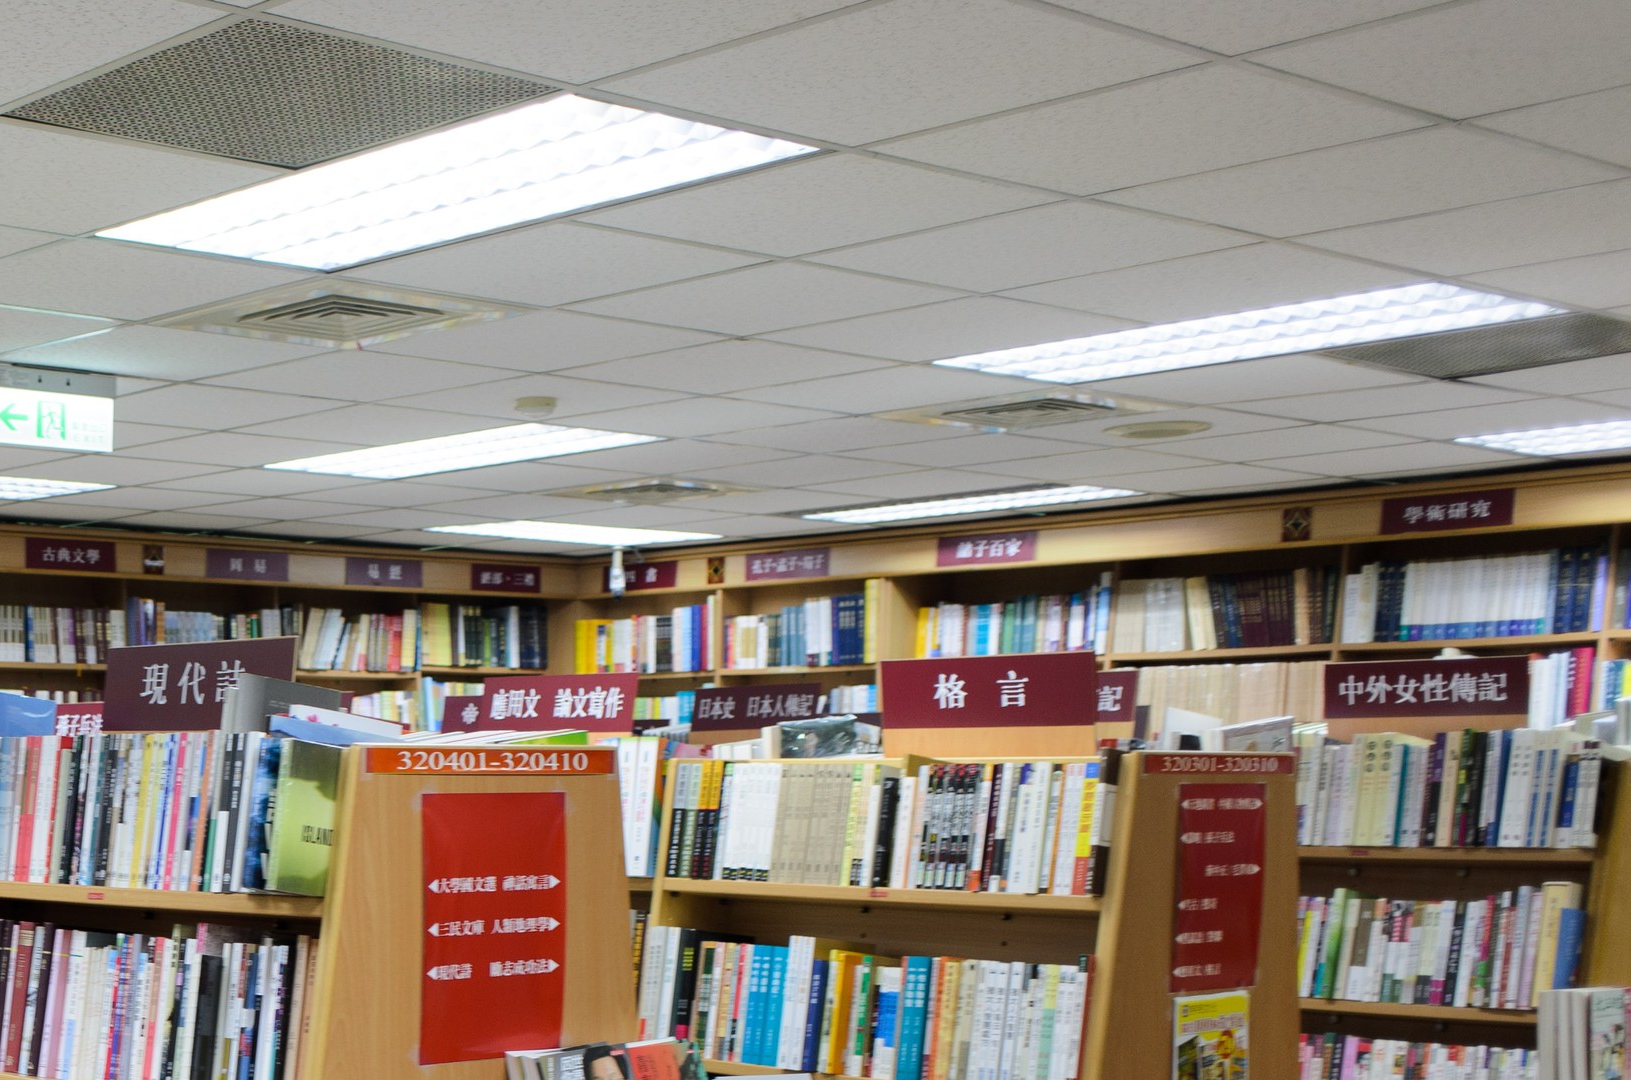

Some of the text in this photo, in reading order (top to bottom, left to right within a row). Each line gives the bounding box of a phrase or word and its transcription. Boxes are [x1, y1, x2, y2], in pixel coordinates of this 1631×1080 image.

[1403, 498, 1492, 524] 學術研究
[42, 547, 100, 564] 古典文學
[139, 660, 246, 706] 現代詩
[933, 670, 1030, 711] 格言
[1338, 672, 1508, 706] 中外女性傳記
[489, 686, 624, 721] 應用文 論文寫作
[697, 698, 735, 722] 日本史
[396, 750, 590, 773] 320401-320410
[1161, 755, 1279, 773] 320301-320310
